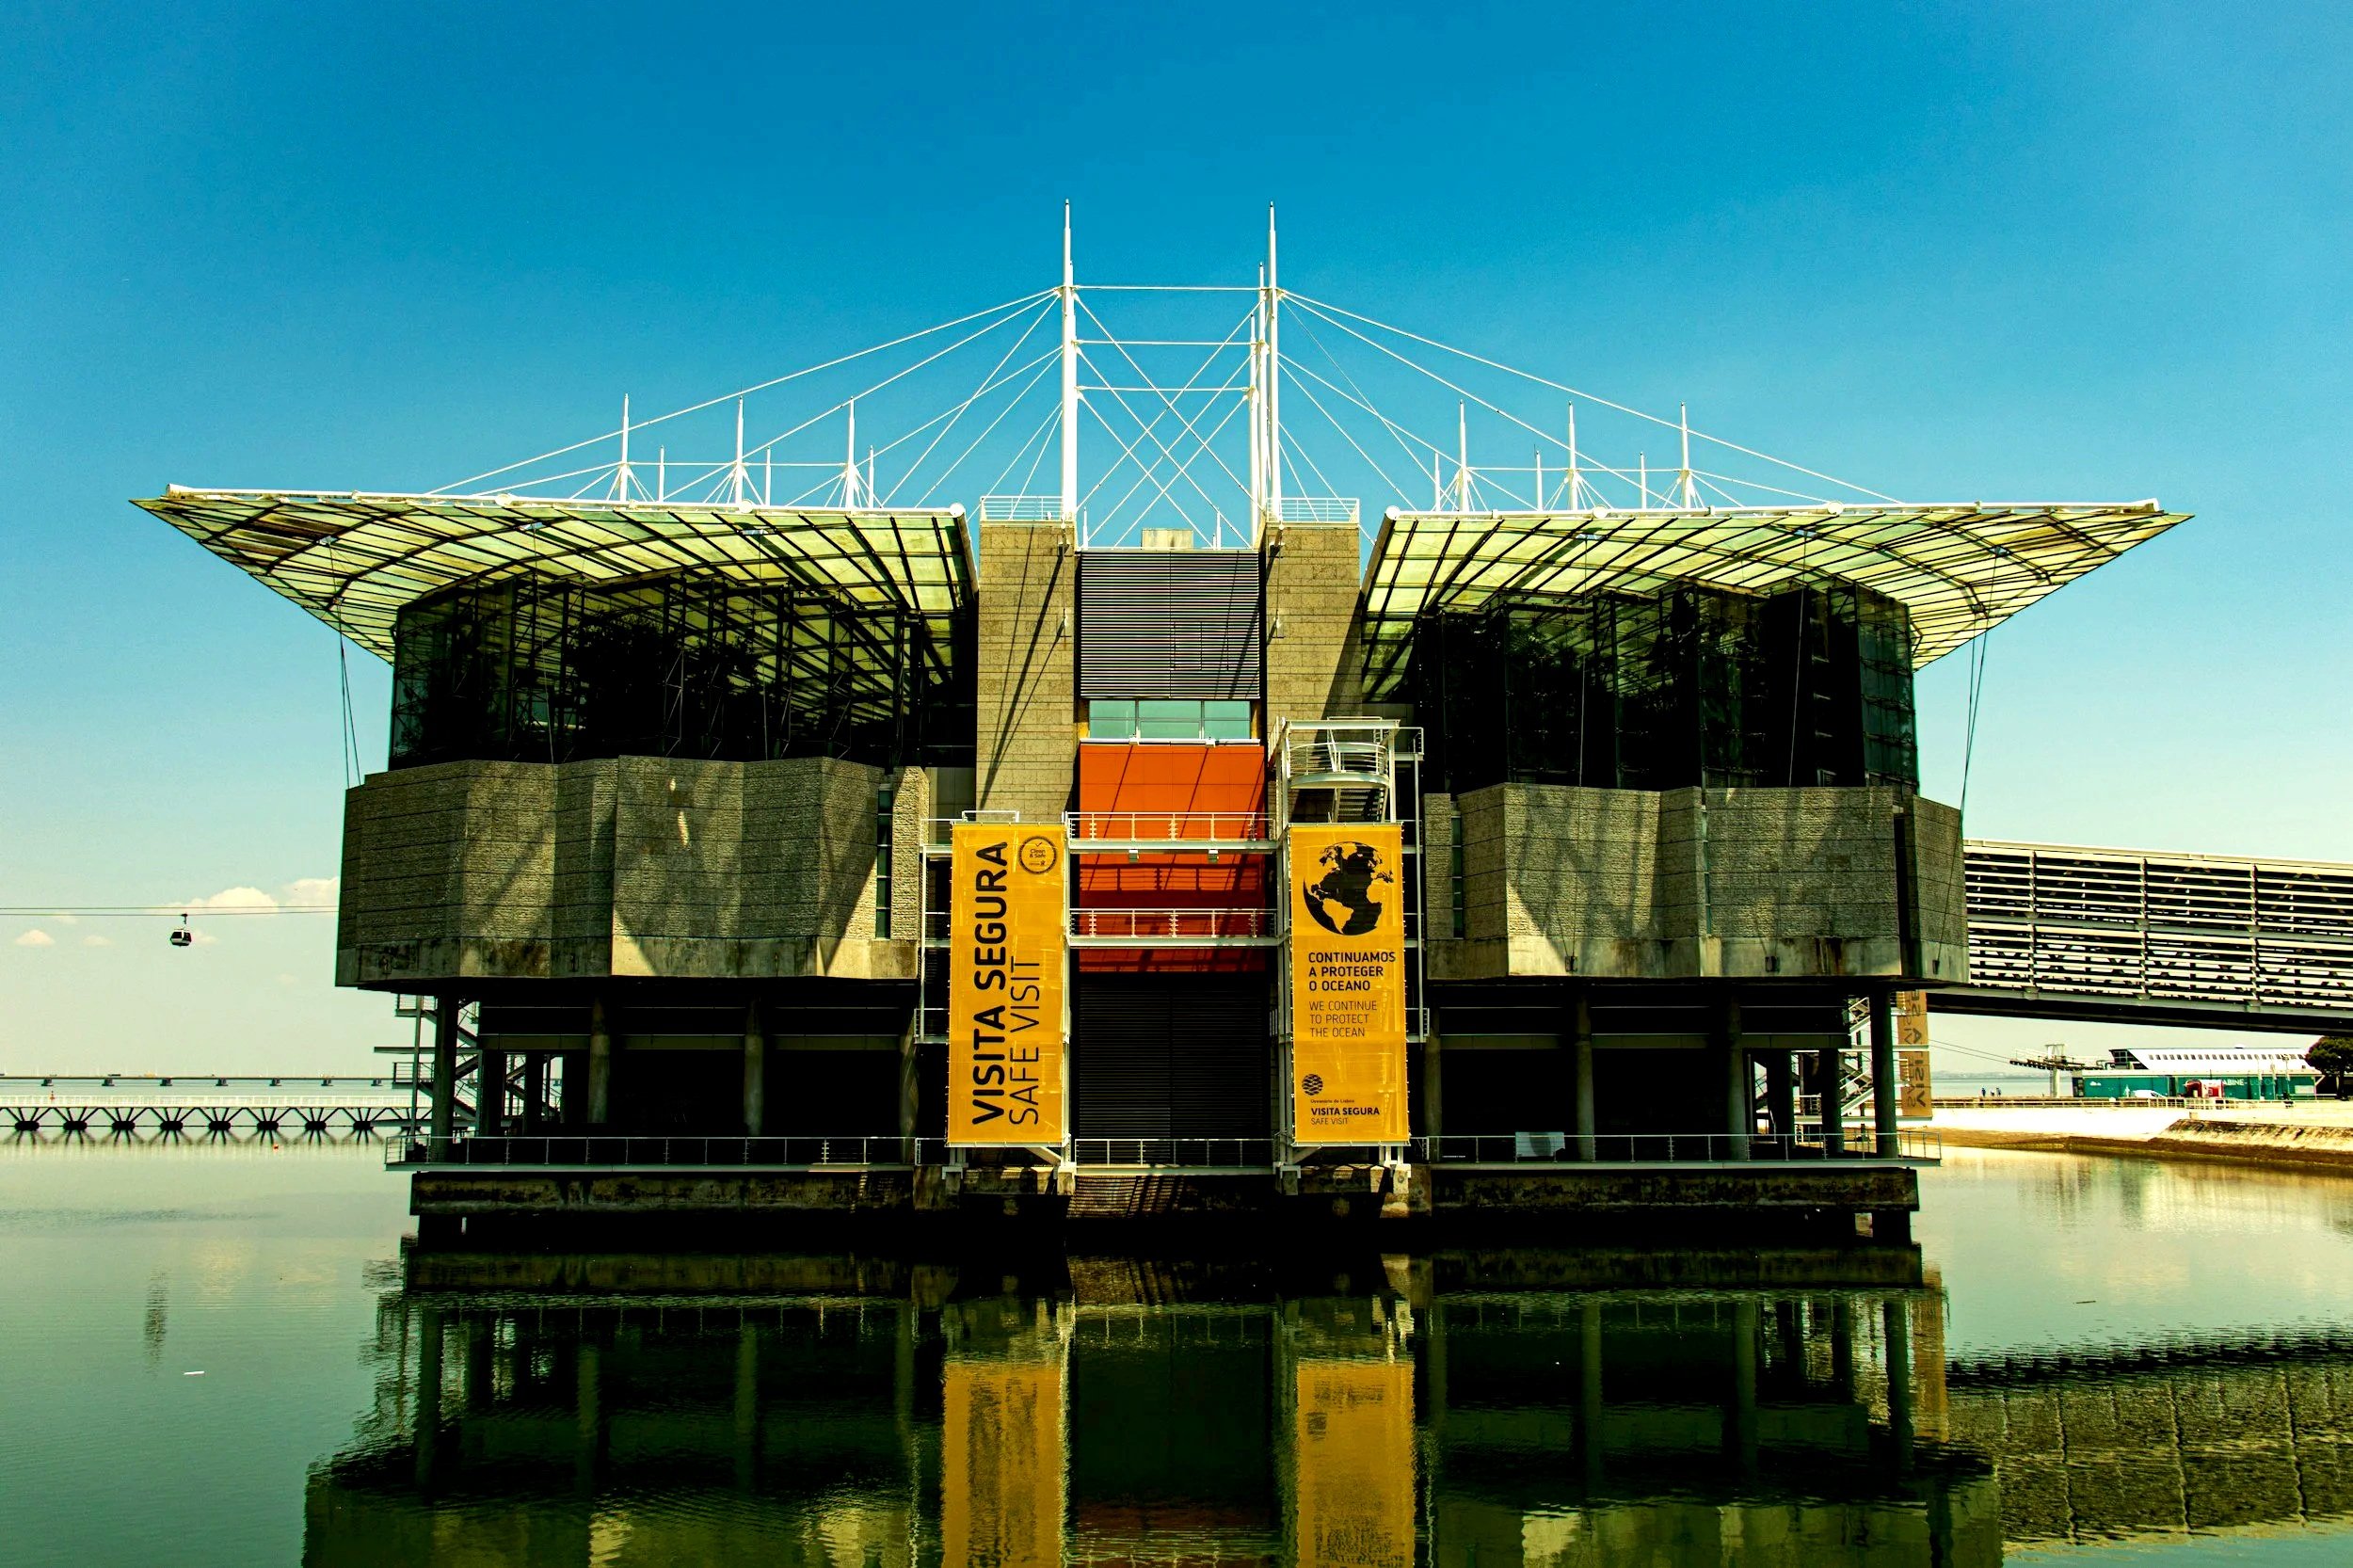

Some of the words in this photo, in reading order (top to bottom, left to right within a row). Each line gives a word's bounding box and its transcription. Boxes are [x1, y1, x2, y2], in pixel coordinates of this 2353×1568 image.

[973, 841, 1008, 991] SEGURA
[1308, 952, 1396, 963] CONTINUAMOS
[1308, 966, 1318, 977] A
[1321, 966, 1384, 977] PROTEGER
[1308, 980, 1318, 991] O
[1321, 980, 1370, 991] OCEANO
[1009, 955, 1040, 1033] VISIT
[1308, 1000, 1324, 1011] WE
[1328, 1000, 1377, 1011] CONTINUE
[1310, 1015, 1322, 1024] TO
[1325, 1014, 1369, 1024] PROTECT
[1310, 1028, 1329, 1037] THE
[1333, 1028, 1366, 1037] OCEAN
[971, 1004, 1006, 1126] VISITA
[1008, 1047, 1039, 1125] SAFE
[1310, 1107, 1340, 1116] VISITA
[1342, 1107, 1380, 1116] SEGURA
[1310, 1117, 1329, 1126] SAFE
[1330, 1117, 1348, 1126] VISIT
